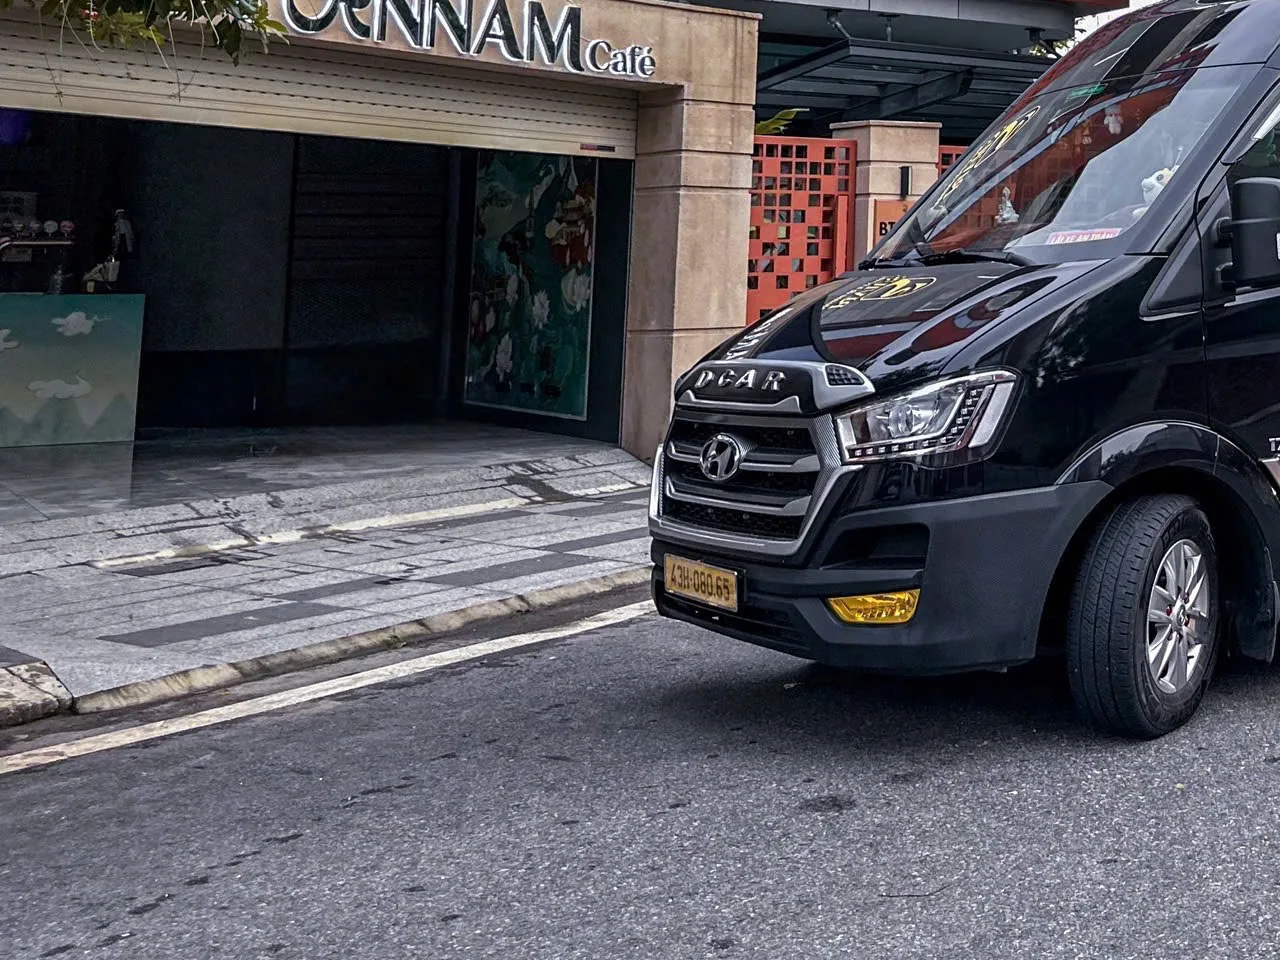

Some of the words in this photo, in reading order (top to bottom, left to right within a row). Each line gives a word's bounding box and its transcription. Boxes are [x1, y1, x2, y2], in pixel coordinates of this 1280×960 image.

[586, 38, 657, 78] Café
[694, 368, 787, 391] DCAR
[670, 563, 730, 601] 43H-080.65
